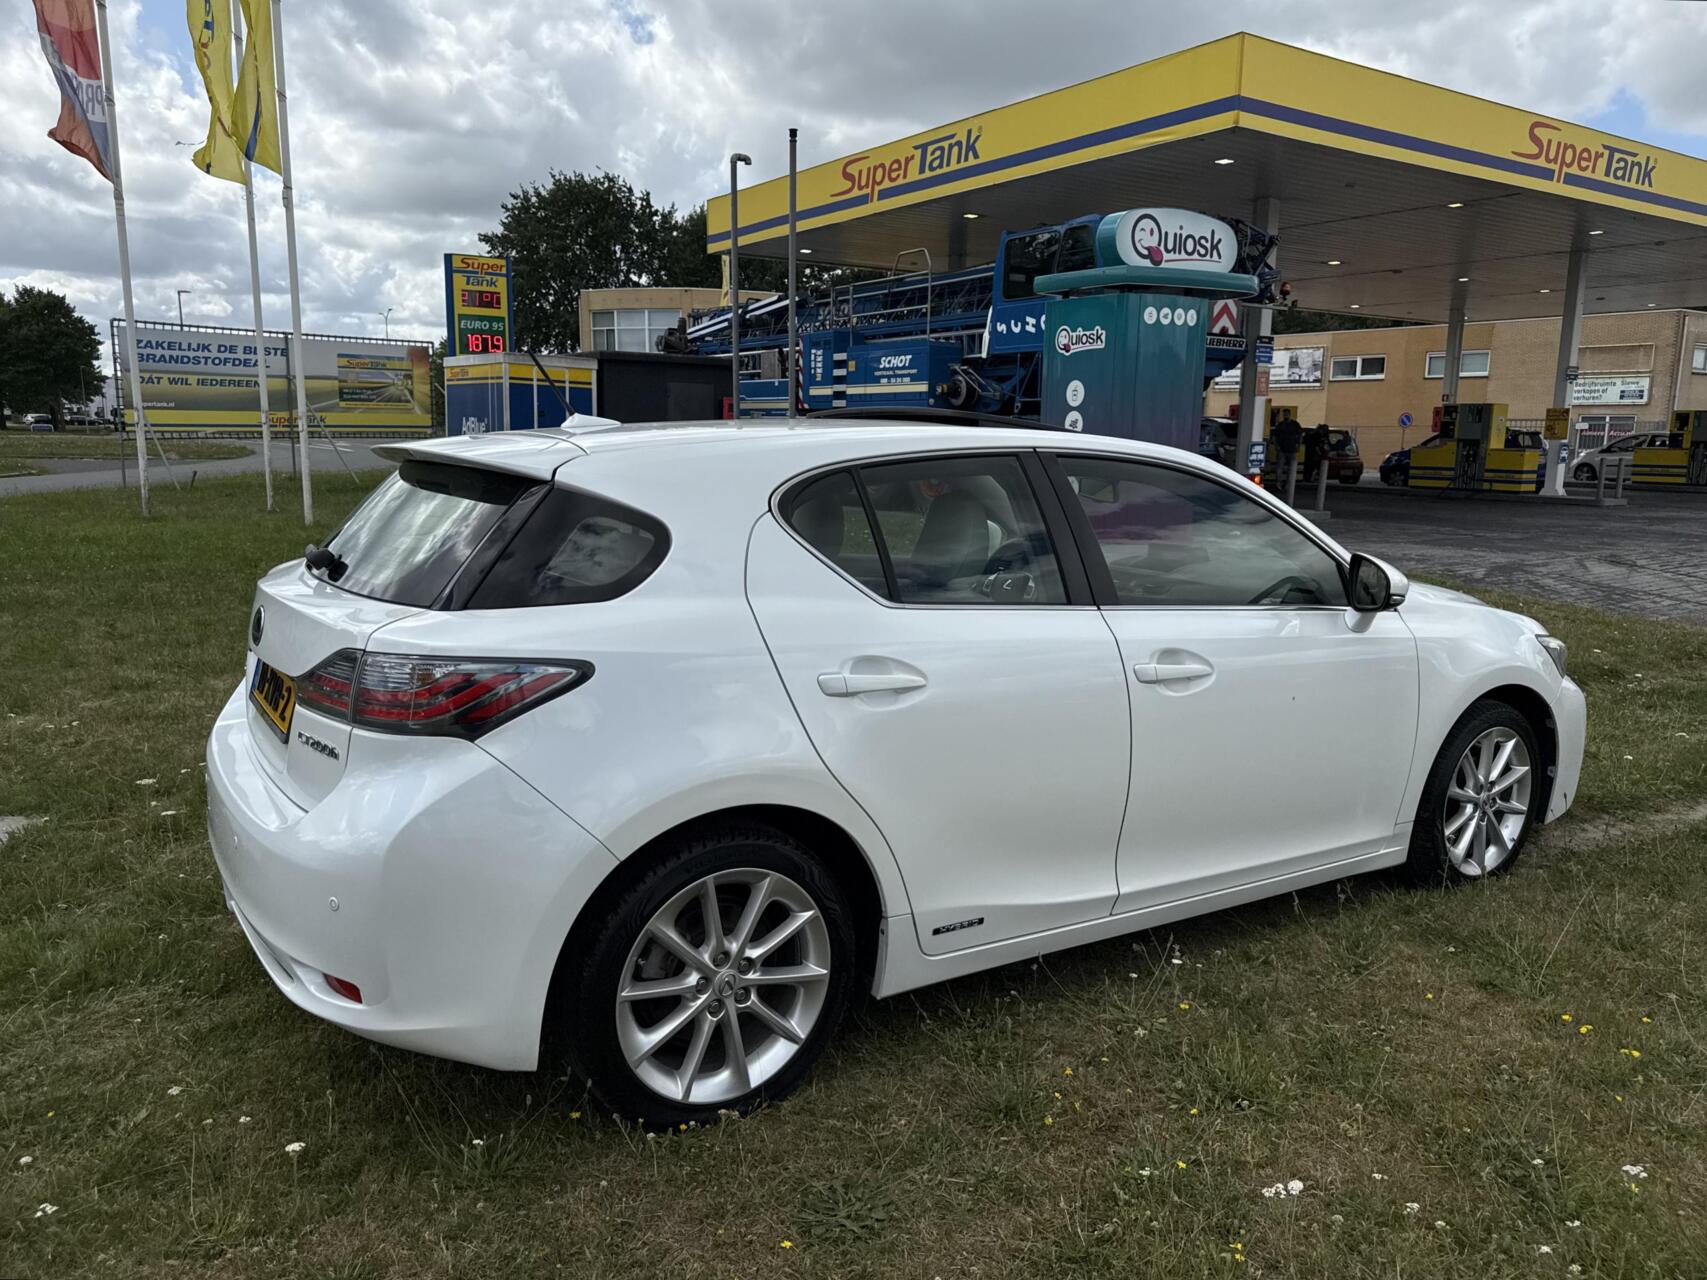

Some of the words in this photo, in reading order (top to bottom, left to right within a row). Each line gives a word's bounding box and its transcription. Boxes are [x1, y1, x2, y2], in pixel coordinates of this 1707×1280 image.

[1131, 213, 1222, 264] Quiosk
[453, 257, 504, 276] Super
[461, 274, 498, 288] Tank
[460, 320, 489, 330] EURO
[492, 322, 504, 331] 95
[136, 339, 212, 353] ZAKELIJK
[217, 344, 237, 355] DE
[1056, 327, 1104, 352] Quiosk
[879, 354, 912, 369] SCHOT
[167, 377, 192, 386] WIL
